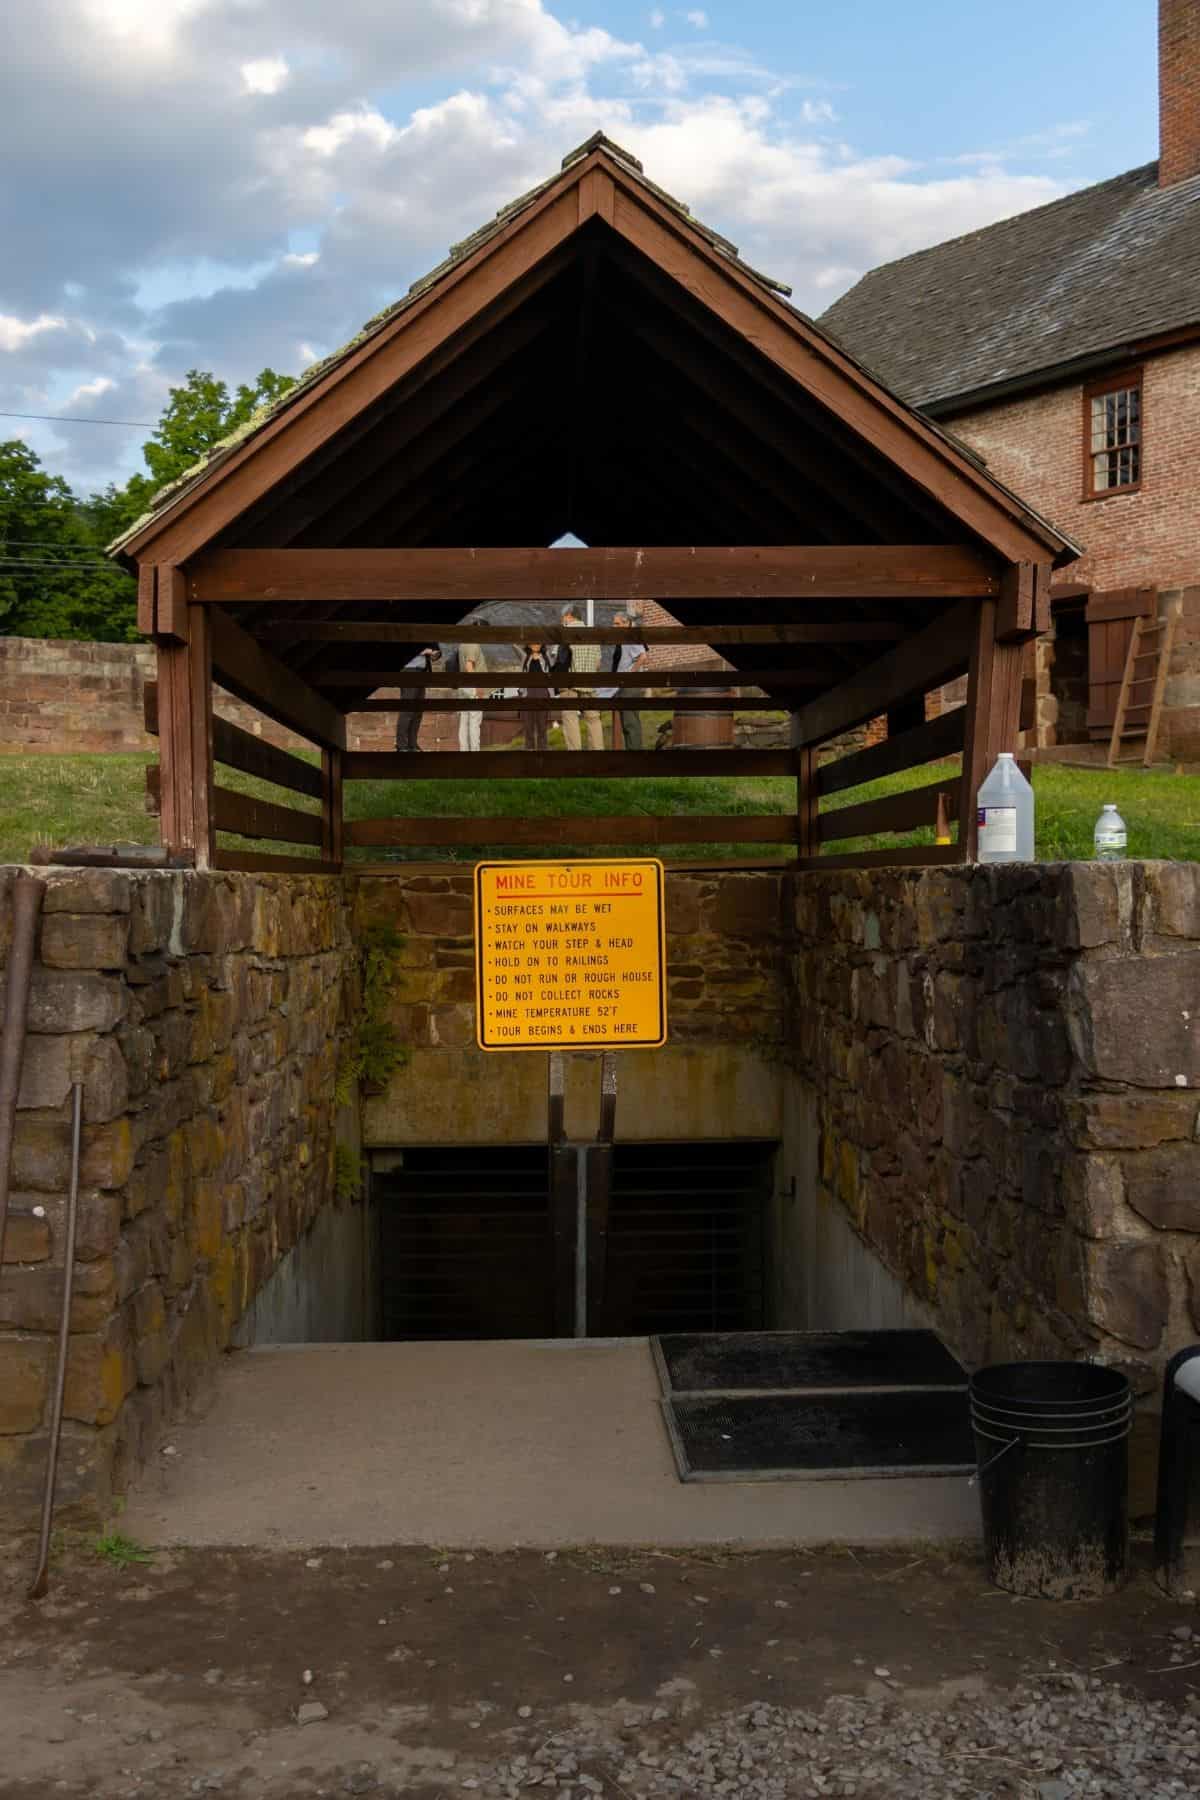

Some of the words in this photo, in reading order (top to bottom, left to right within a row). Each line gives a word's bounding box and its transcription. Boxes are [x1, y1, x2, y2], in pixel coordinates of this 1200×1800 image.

[496, 875, 536, 890] MINE
[548, 874, 592, 888] TOUR
[605, 873, 643, 887] INFO
[494, 906, 544, 916] SURFACES
[551, 905, 569, 914] MAY
[575, 905, 587, 913] BE
[594, 904, 612, 913] WET
[495, 924, 518, 934] STAY
[525, 924, 538, 932] ON
[546, 922, 596, 932] WALKWAYS
[495, 941, 525, 950] WATCH
[533, 940, 558, 949] YOUR
[566, 939, 589, 949] STEP
[596, 939, 601, 948] &
[609, 938, 633, 948] HEAD
[495, 958, 520, 967] HOLD
[527, 957, 539, 966] ON
[547, 957, 558, 966] TO
[566, 955, 609, 966] RAILINGS
[495, 975, 507, 984] DO
[515, 975, 532, 984] NOT
[540, 974, 558, 983] RUN
[565, 974, 577, 983] OR
[584, 973, 615, 982] ROUGH
[622, 972, 653, 981] HOUSE
[496, 992, 508, 1001] DO
[516, 991, 533, 1001] NOT
[541, 990, 581, 1000] COLLECT
[589, 989, 620, 999] ROCKS
[496, 1009, 518, 1018] MINE
[525, 1007, 591, 1018] TEMPERATURE
[497, 1026, 520, 1036] TOUR
[528, 1025, 562, 1035] BEGINS
[569, 1025, 575, 1034] &
[583, 1024, 607, 1034] ENDS
[614, 1024, 638, 1033] HERE
